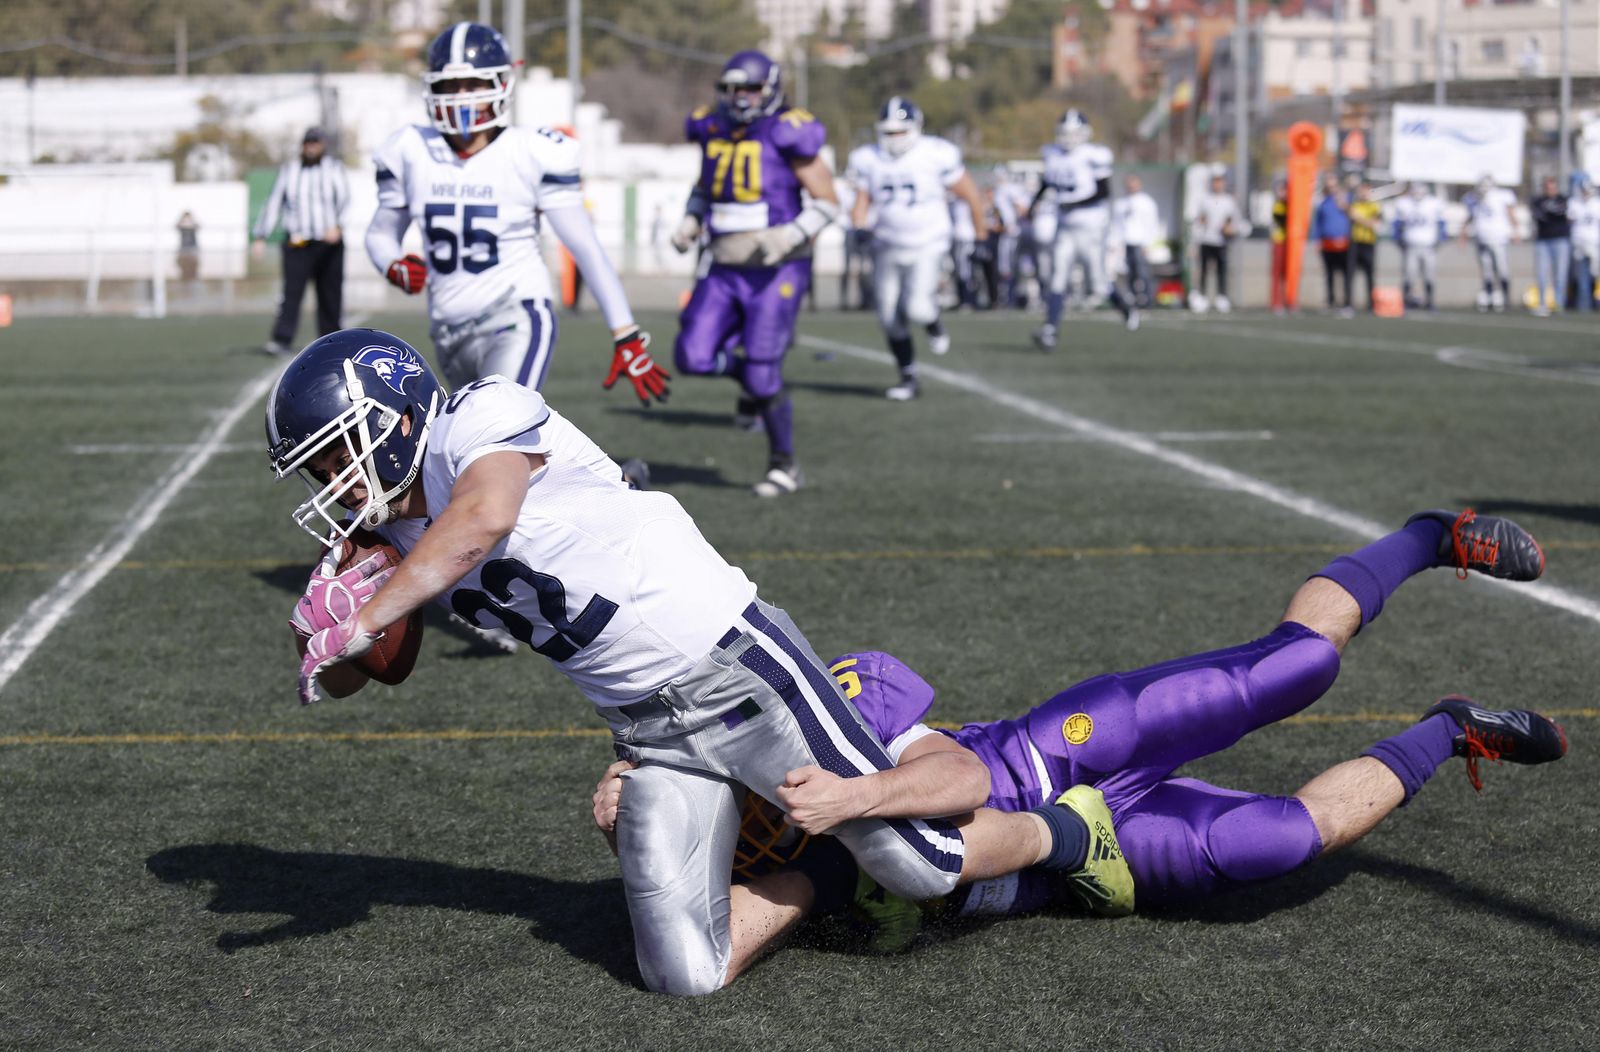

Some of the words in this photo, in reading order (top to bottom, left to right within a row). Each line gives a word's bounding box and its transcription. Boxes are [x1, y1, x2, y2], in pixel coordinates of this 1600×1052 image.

[706, 140, 762, 202] 70
[425, 203, 499, 275] 55
[451, 558, 619, 662] 22
